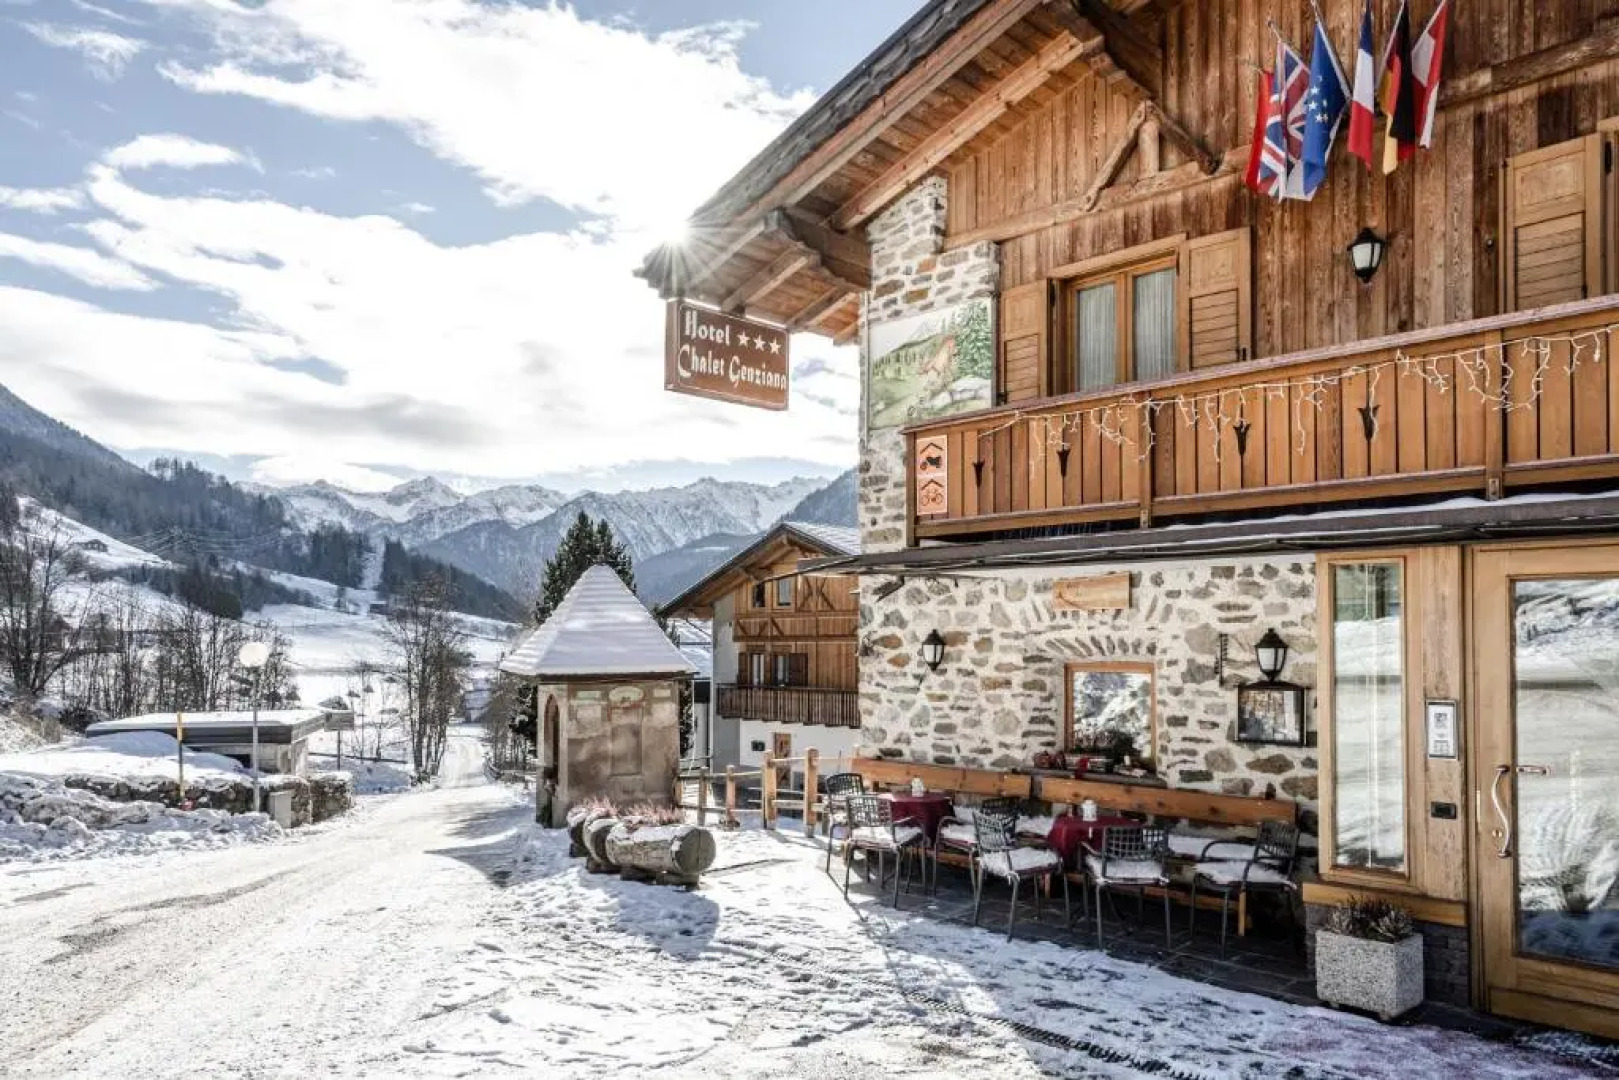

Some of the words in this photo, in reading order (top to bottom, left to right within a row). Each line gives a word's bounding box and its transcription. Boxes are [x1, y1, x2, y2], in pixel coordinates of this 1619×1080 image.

[685, 310, 730, 346] Hotel
[678, 343, 725, 378] Chalet
[728, 355, 787, 390] Genziana
